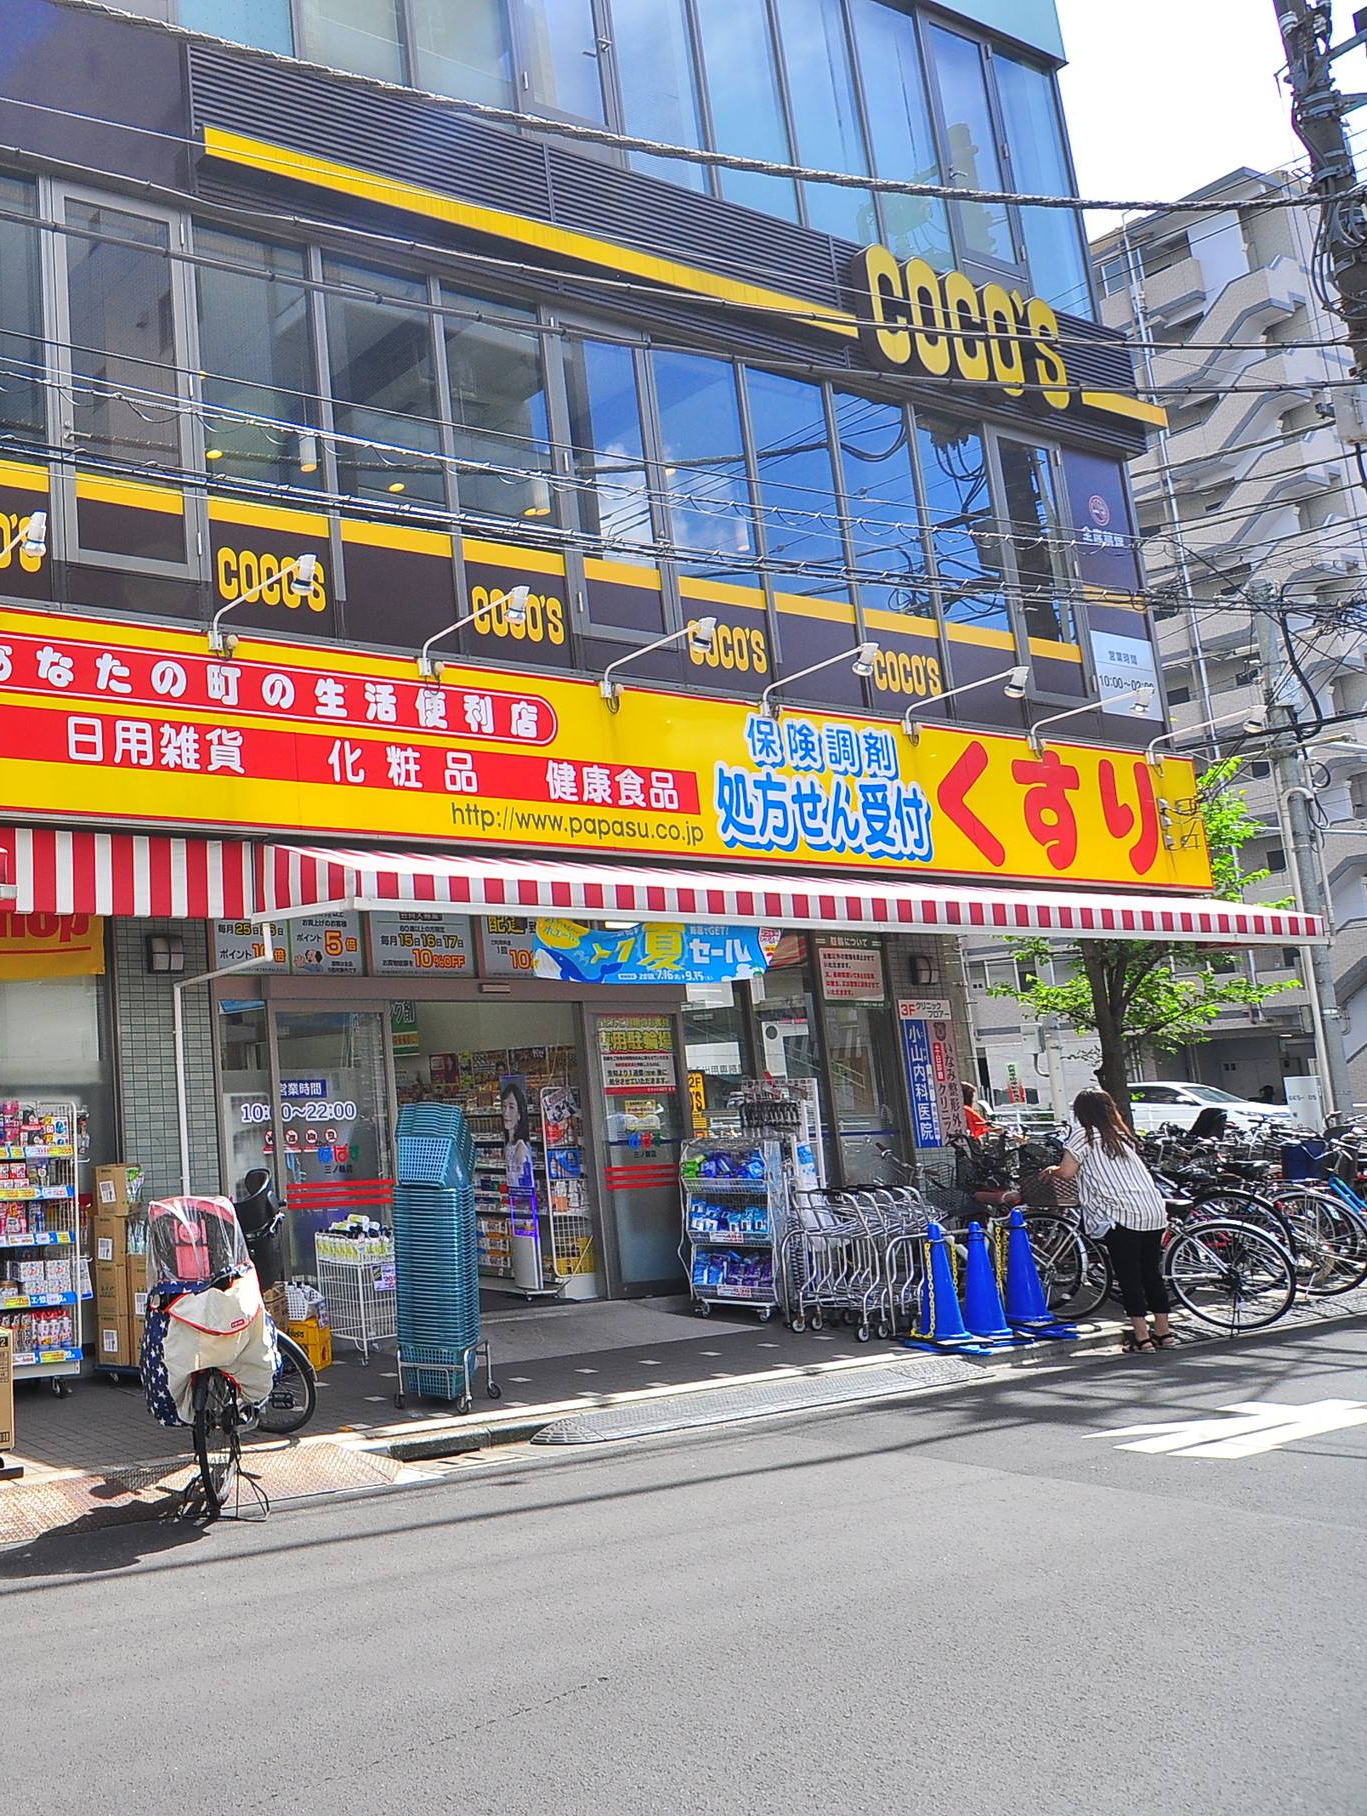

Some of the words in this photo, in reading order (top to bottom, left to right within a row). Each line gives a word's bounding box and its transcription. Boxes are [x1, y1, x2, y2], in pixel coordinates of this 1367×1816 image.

[864, 244, 1070, 410] COCO'S
[874, 650, 943, 696] COCO'S
[67, 715, 245, 775] 日用雑貨
[328, 740, 478, 794] 化粧品
[546, 760, 679, 811] 健康食品
[745, 716, 898, 780] 保険調剤
[450, 802, 705, 844] http://www.papasu.co.jp
[714, 762, 933, 862] 処方せん受付
[937, 740, 1159, 876] くすり
[637, 922, 686, 971] 夏
[690, 938, 753, 964] セール
[900, 1004, 916, 1016] 3F
[909, 1025, 934, 1140] 小山内科医院
